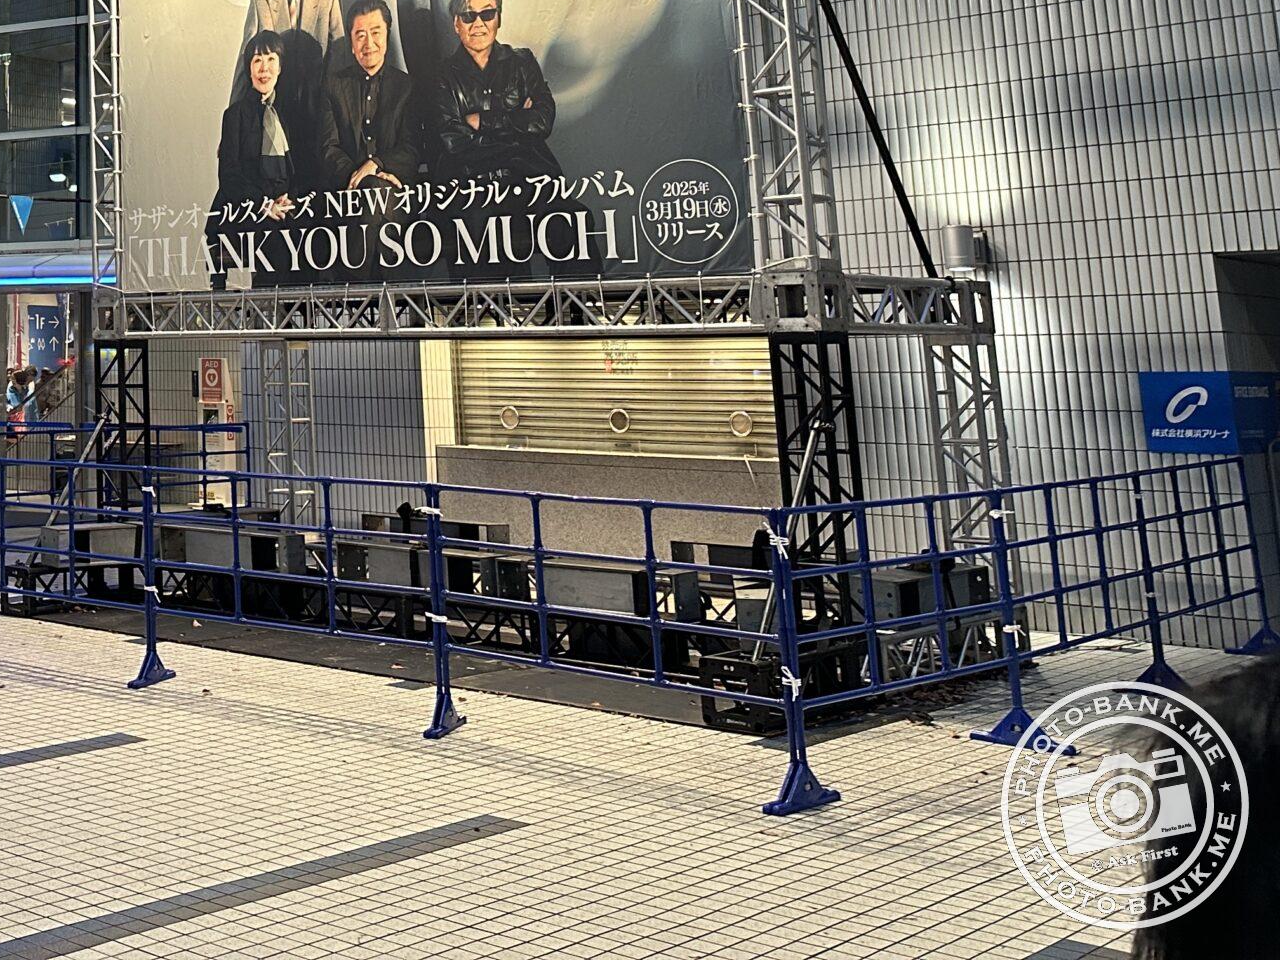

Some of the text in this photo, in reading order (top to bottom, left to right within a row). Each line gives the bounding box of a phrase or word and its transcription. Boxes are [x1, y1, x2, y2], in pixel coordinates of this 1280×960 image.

[662, 180, 710, 198] 2025年
[128, 191, 317, 233] サザンオールスターズ
[656, 221, 724, 247] リリース
[279, 223, 369, 271] YOU
[378, 220, 443, 268] SO
[204, 360, 219, 369] AED
[1151, 428, 1230, 439] 株式会社横浜アリーナ
